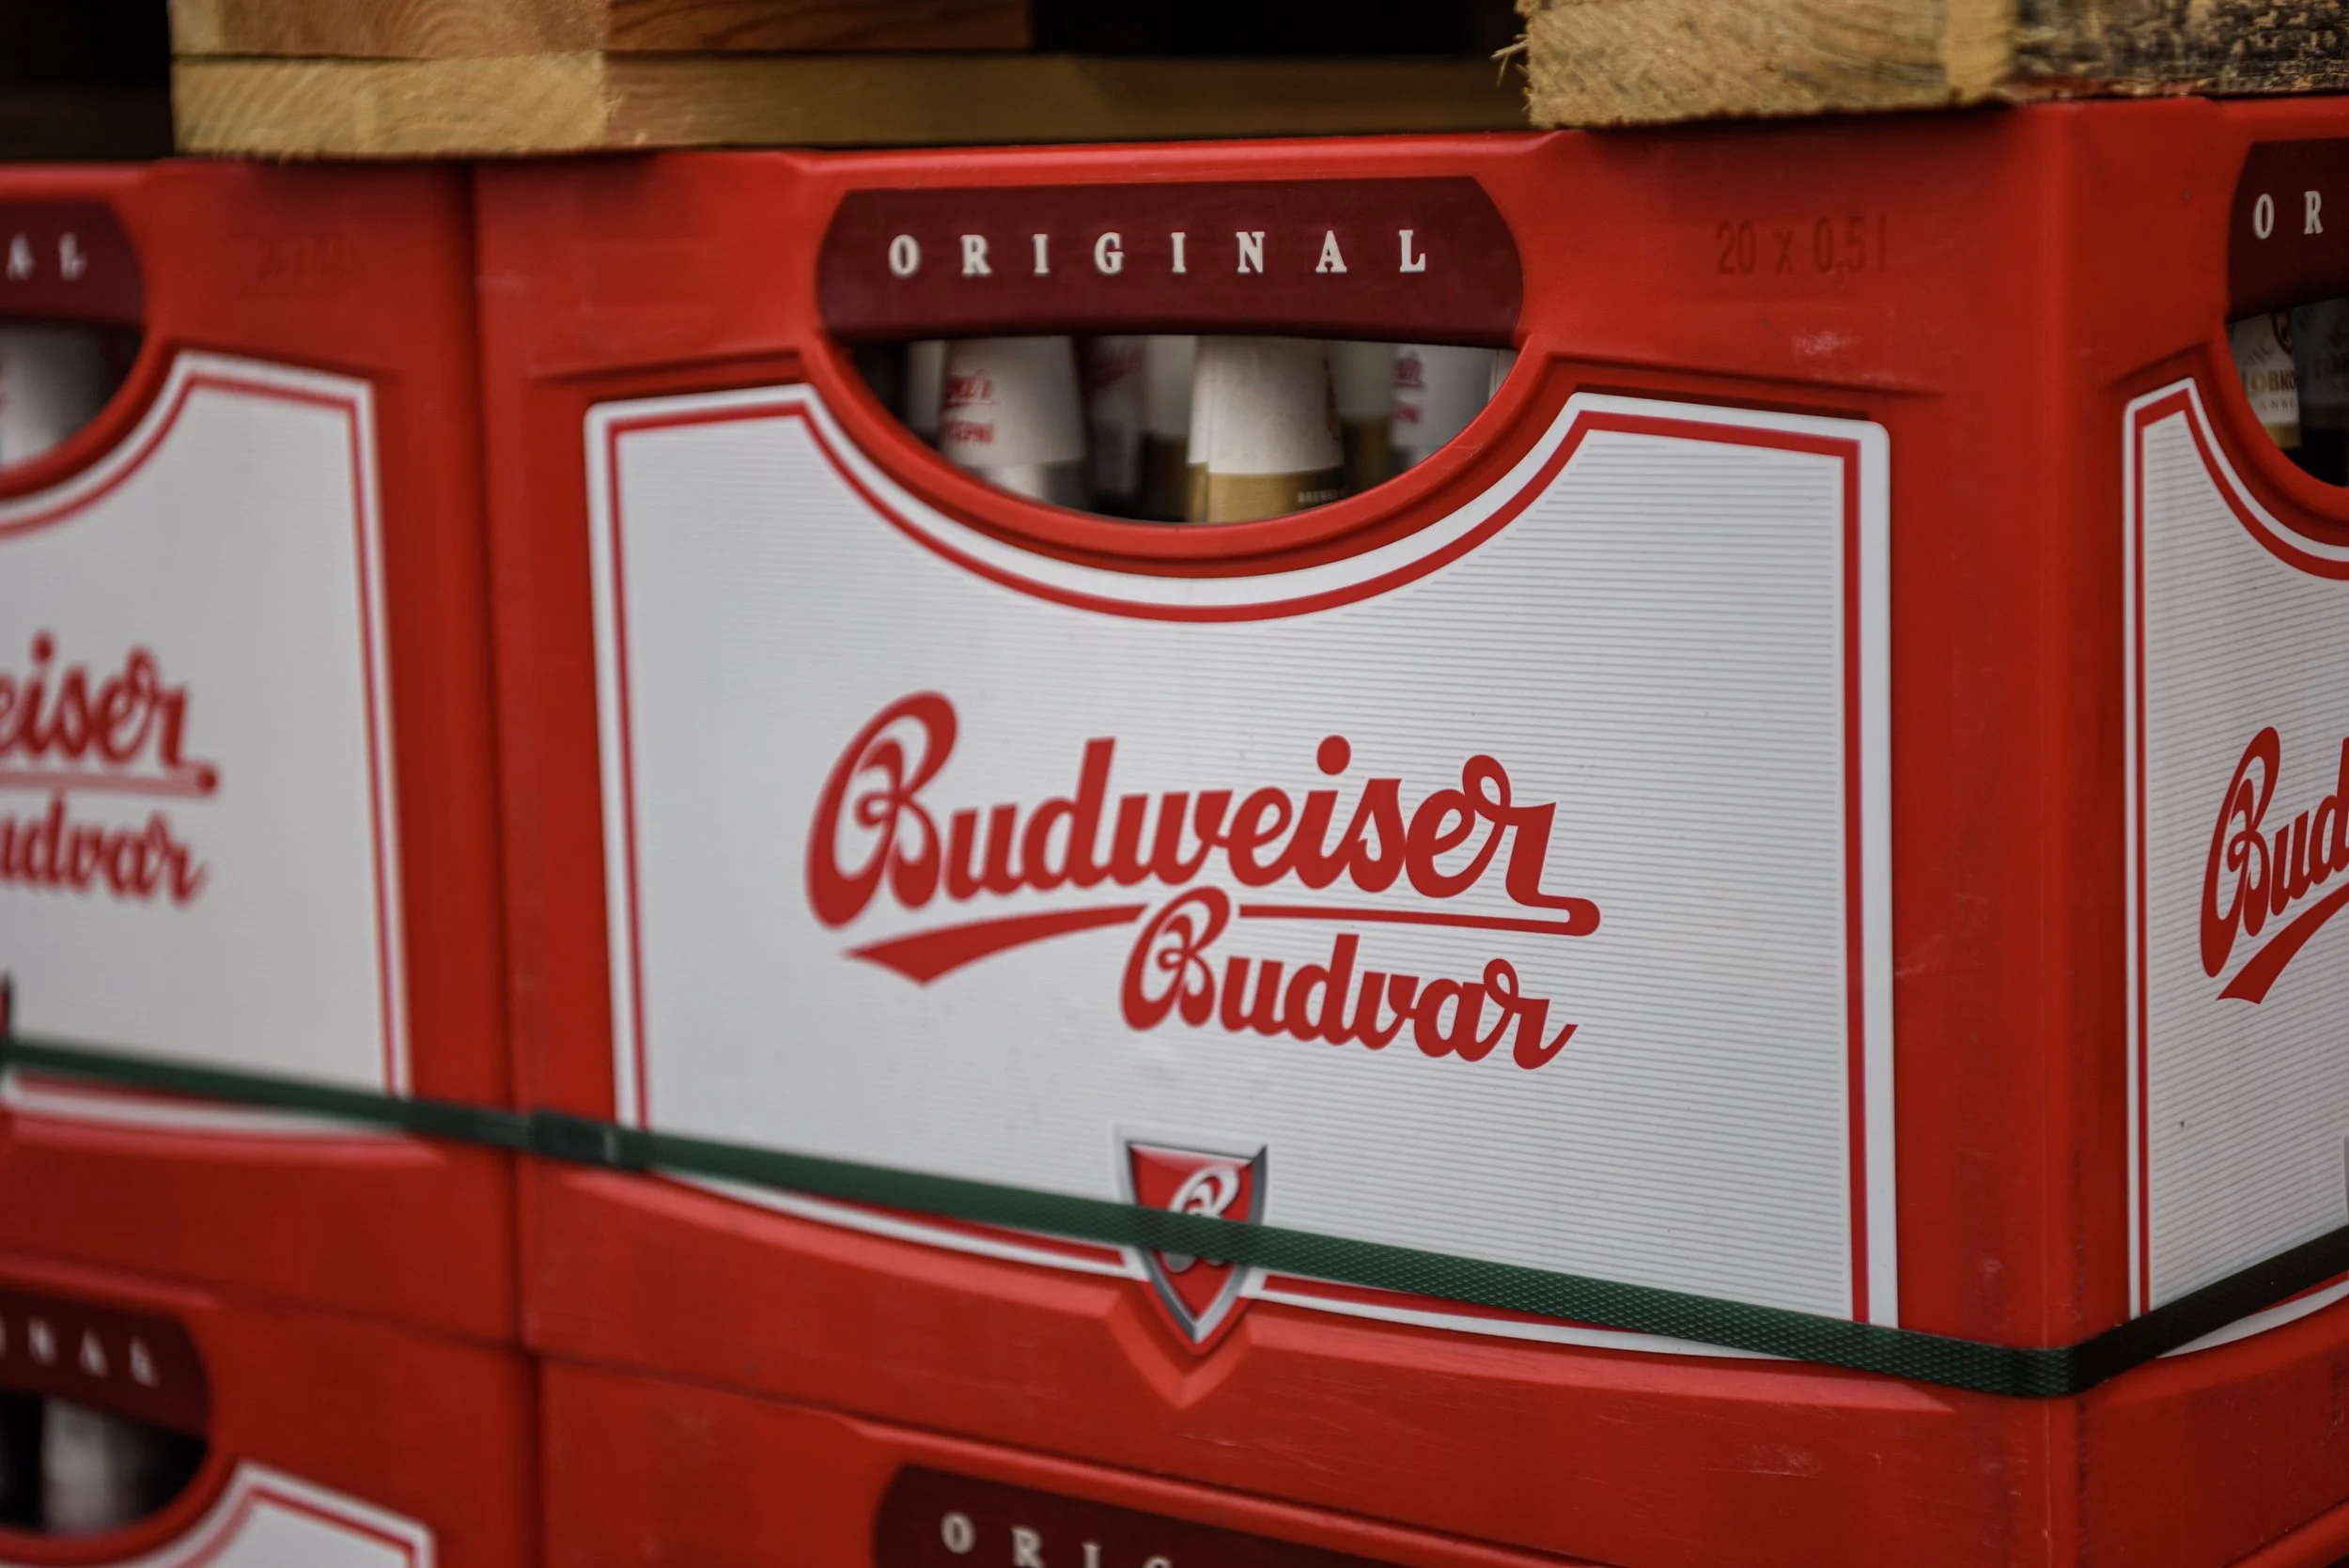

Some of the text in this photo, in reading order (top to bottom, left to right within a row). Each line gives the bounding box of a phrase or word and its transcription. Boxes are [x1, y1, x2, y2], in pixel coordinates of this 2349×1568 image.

[2253, 190, 2324, 239] OR
[889, 229, 1426, 277] ORIGINAL
[1717, 218, 1756, 275] 20
[1774, 228, 1795, 275] x
[1813, 215, 1867, 283] 0,5
[803, 689, 1602, 937] Budweiser
[1120, 886, 1579, 1070] Budvar
[940, 1510, 1174, 1568] ORI
